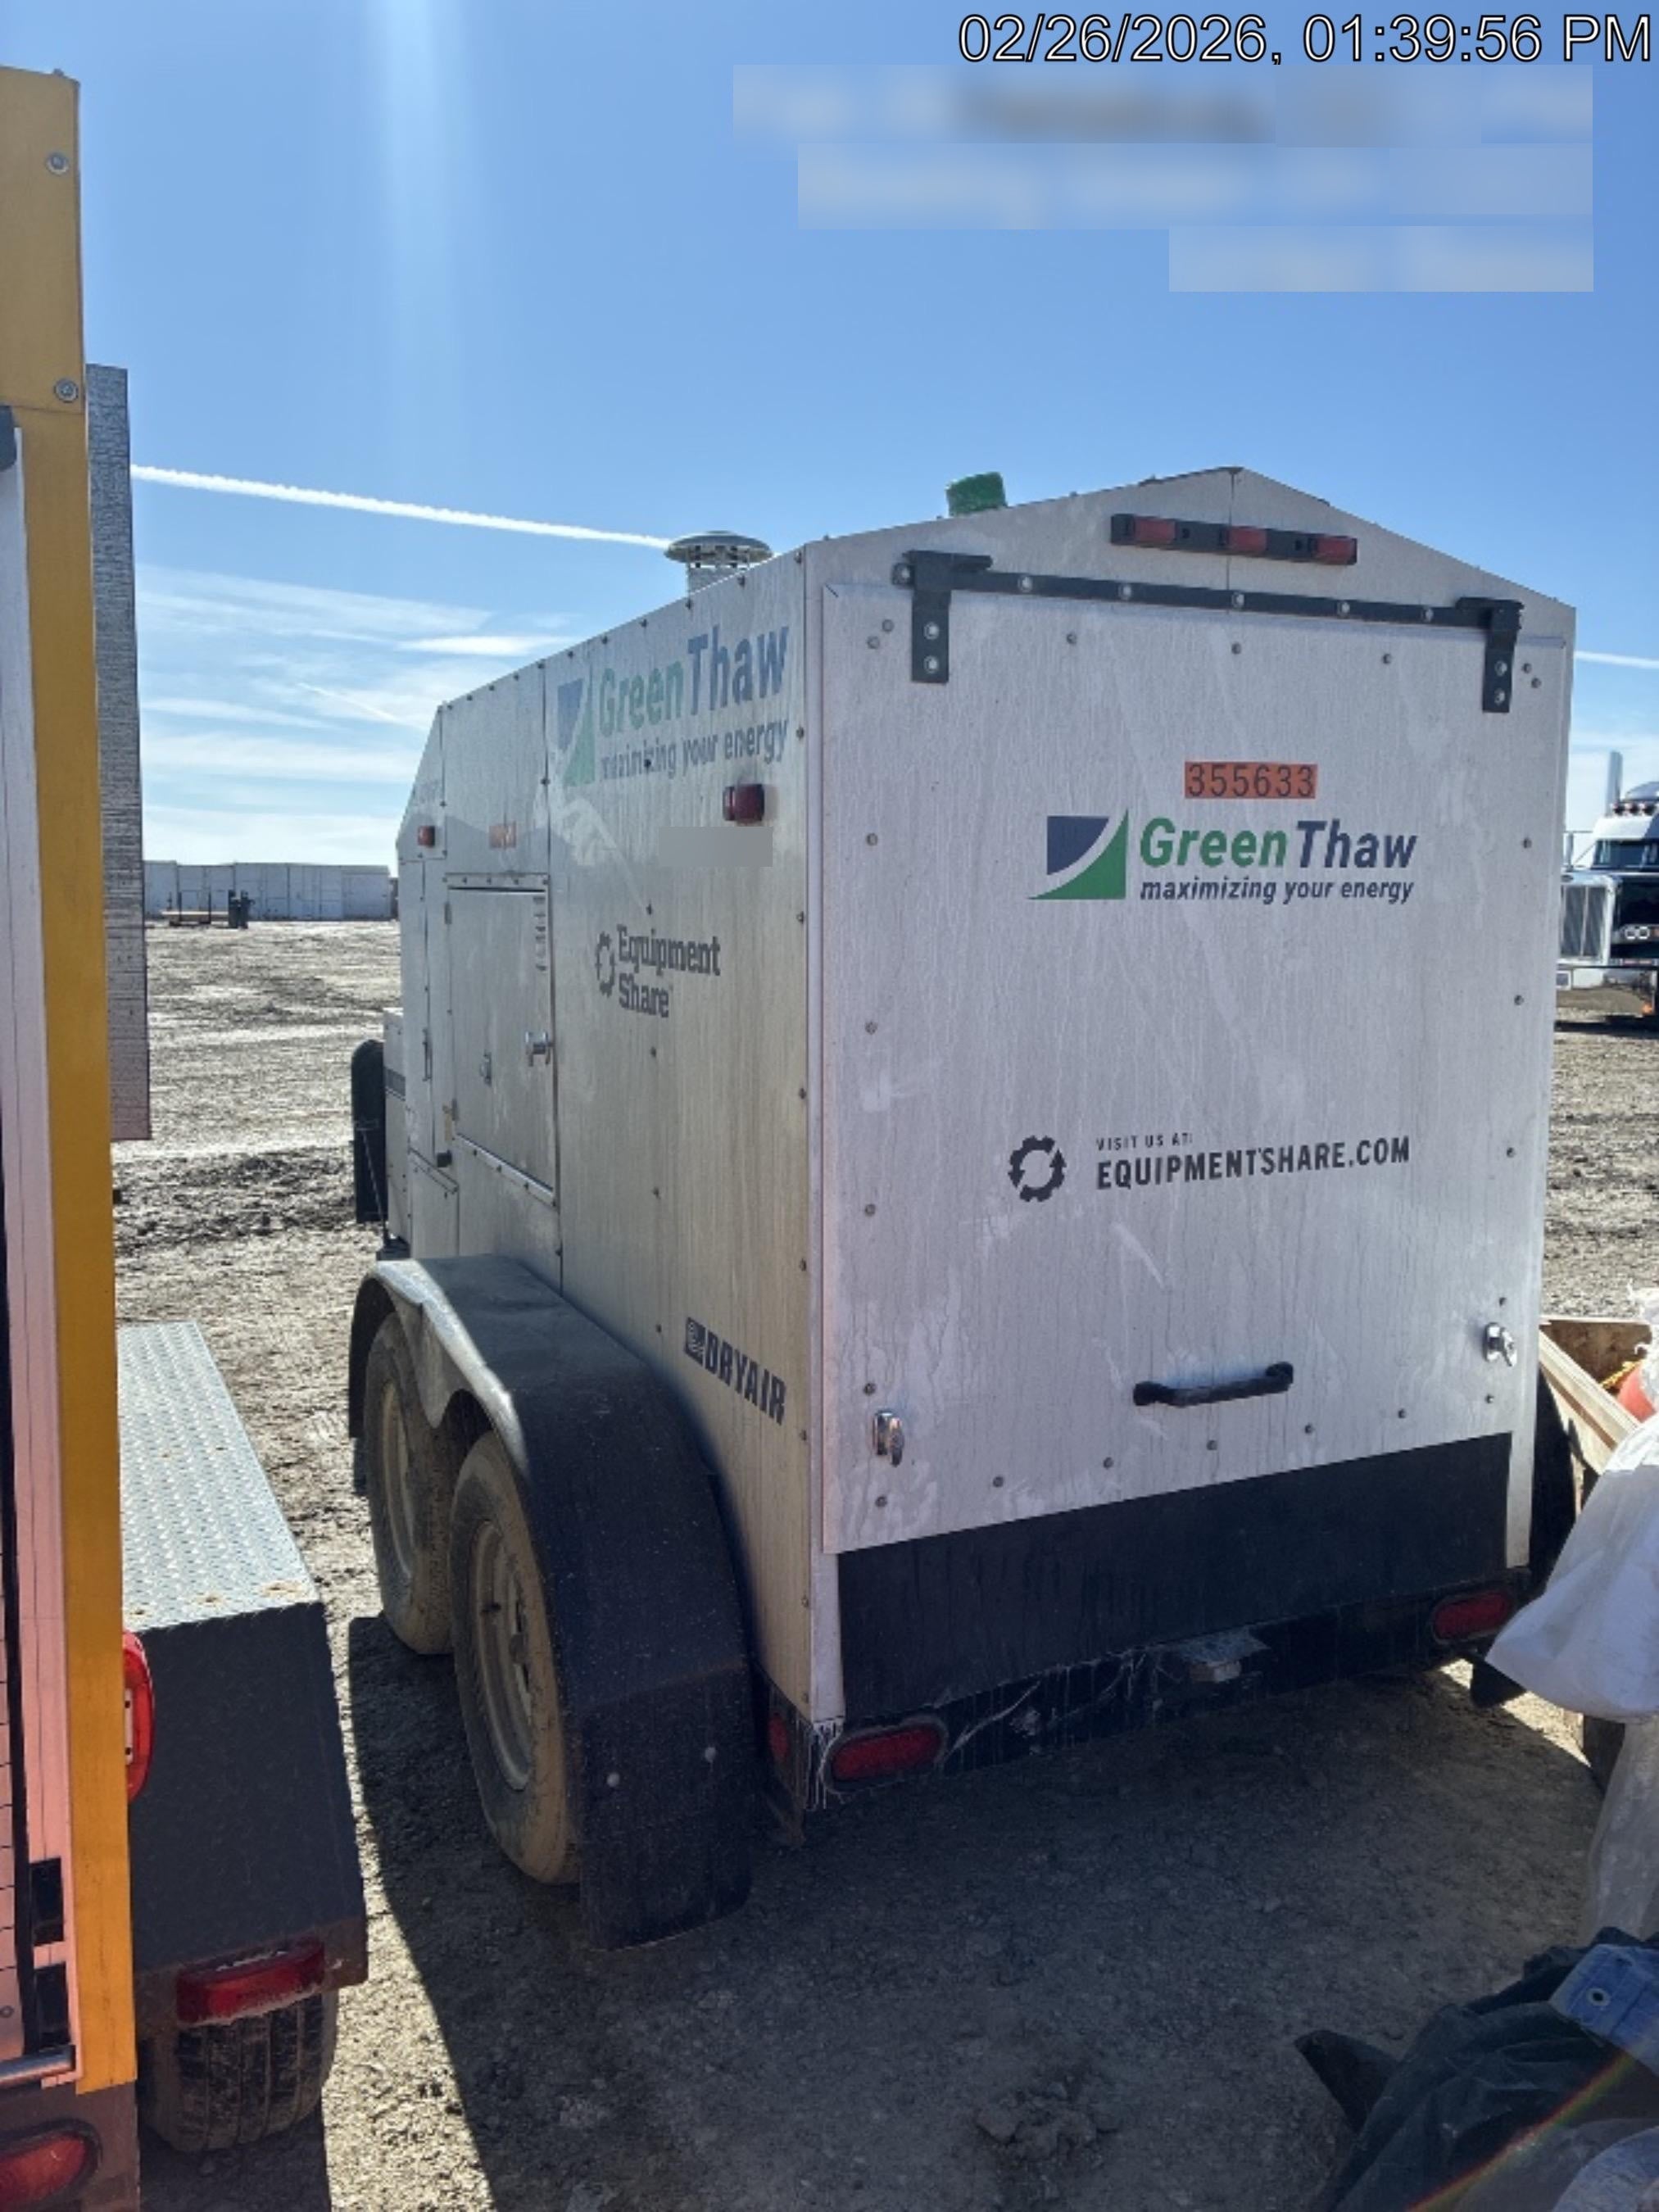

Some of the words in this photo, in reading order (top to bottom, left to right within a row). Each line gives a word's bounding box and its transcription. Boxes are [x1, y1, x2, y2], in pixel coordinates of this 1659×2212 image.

[682, 737, 718, 775] your
[725, 718, 789, 764] energy
[1187, 764, 1314, 797] 355633
[1140, 875, 1277, 904] maximizing
[1282, 881, 1334, 904] your
[1341, 880, 1413, 904] energy
[616, 923, 721, 977] Equipment
[619, 972, 670, 1018] Share
[1096, 1135, 1139, 1151] VISIT
[1145, 1135, 1164, 1149] US
[1097, 1136, 1411, 1190] EQUIPMENTSHARE.COM
[705, 1330, 786, 1426] DRYAIR
